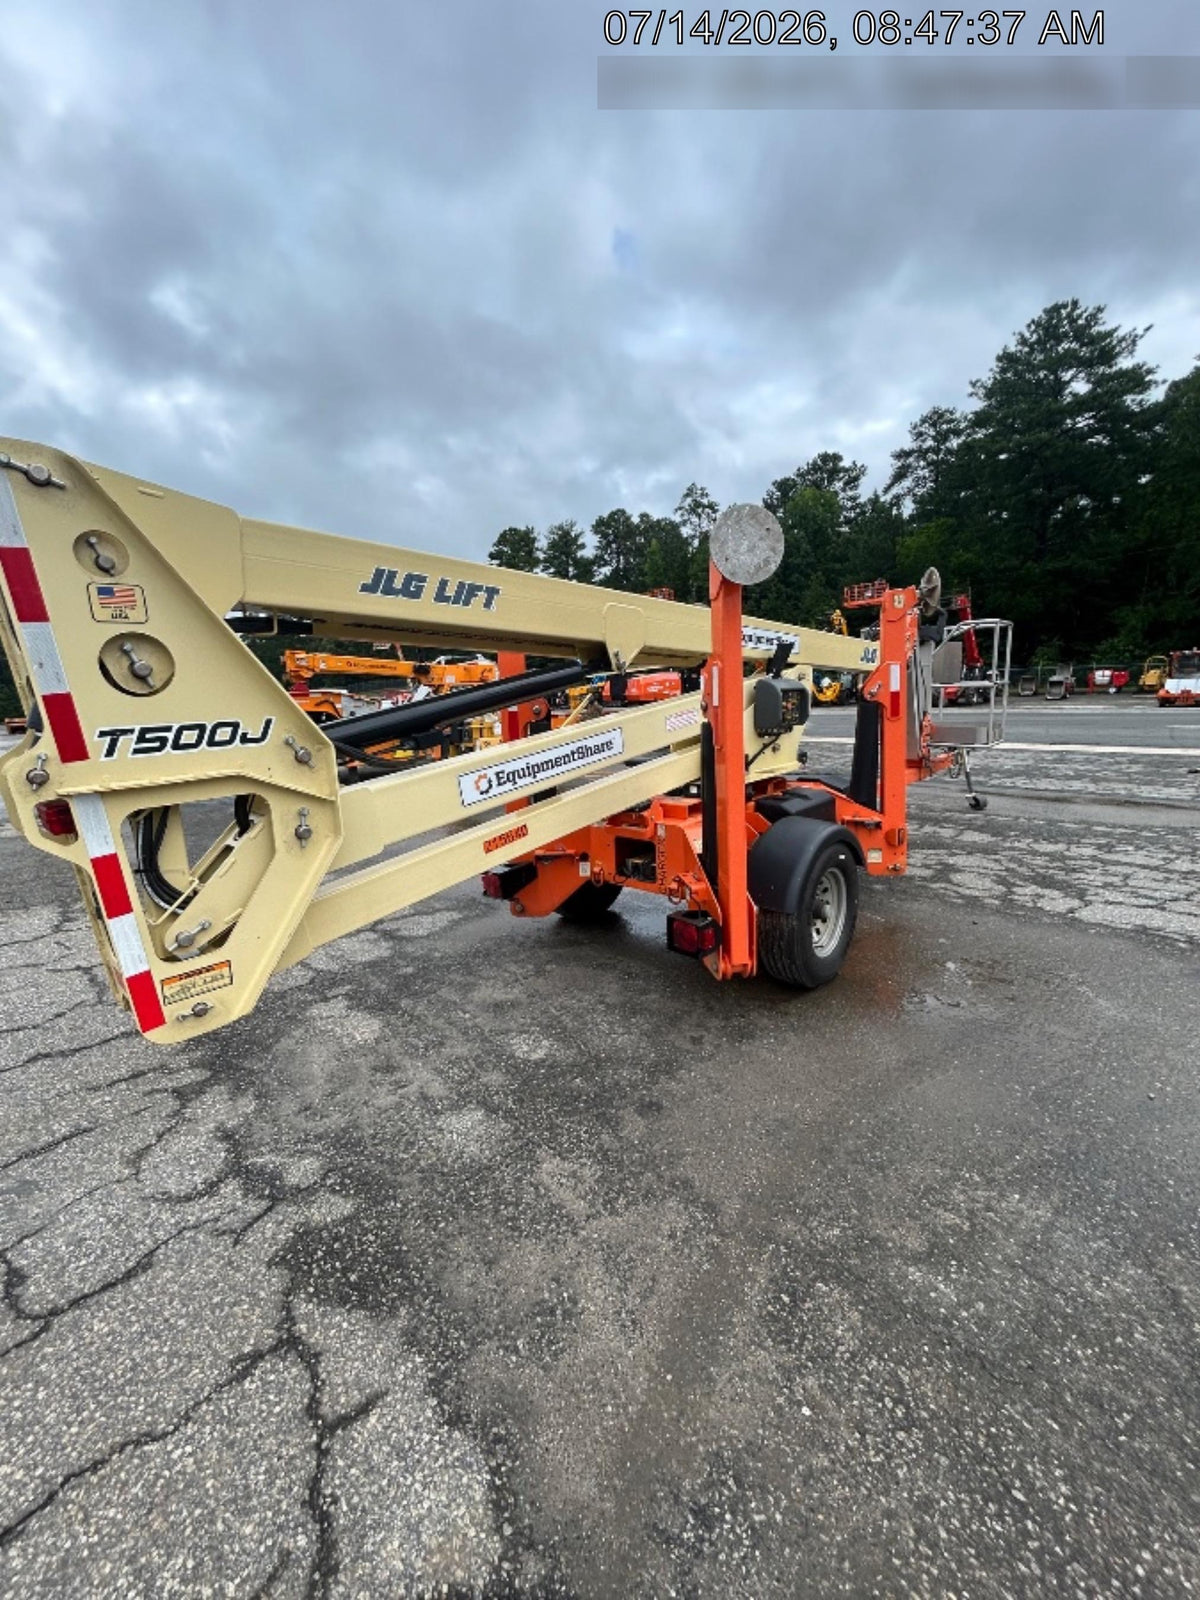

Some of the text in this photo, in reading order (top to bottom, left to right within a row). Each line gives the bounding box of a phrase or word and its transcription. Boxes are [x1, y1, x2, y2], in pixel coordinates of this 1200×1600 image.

[359, 566, 501, 611] JLG LIFT
[96, 717, 274, 759] T500J
[495, 738, 615, 787] EquipmentShare
